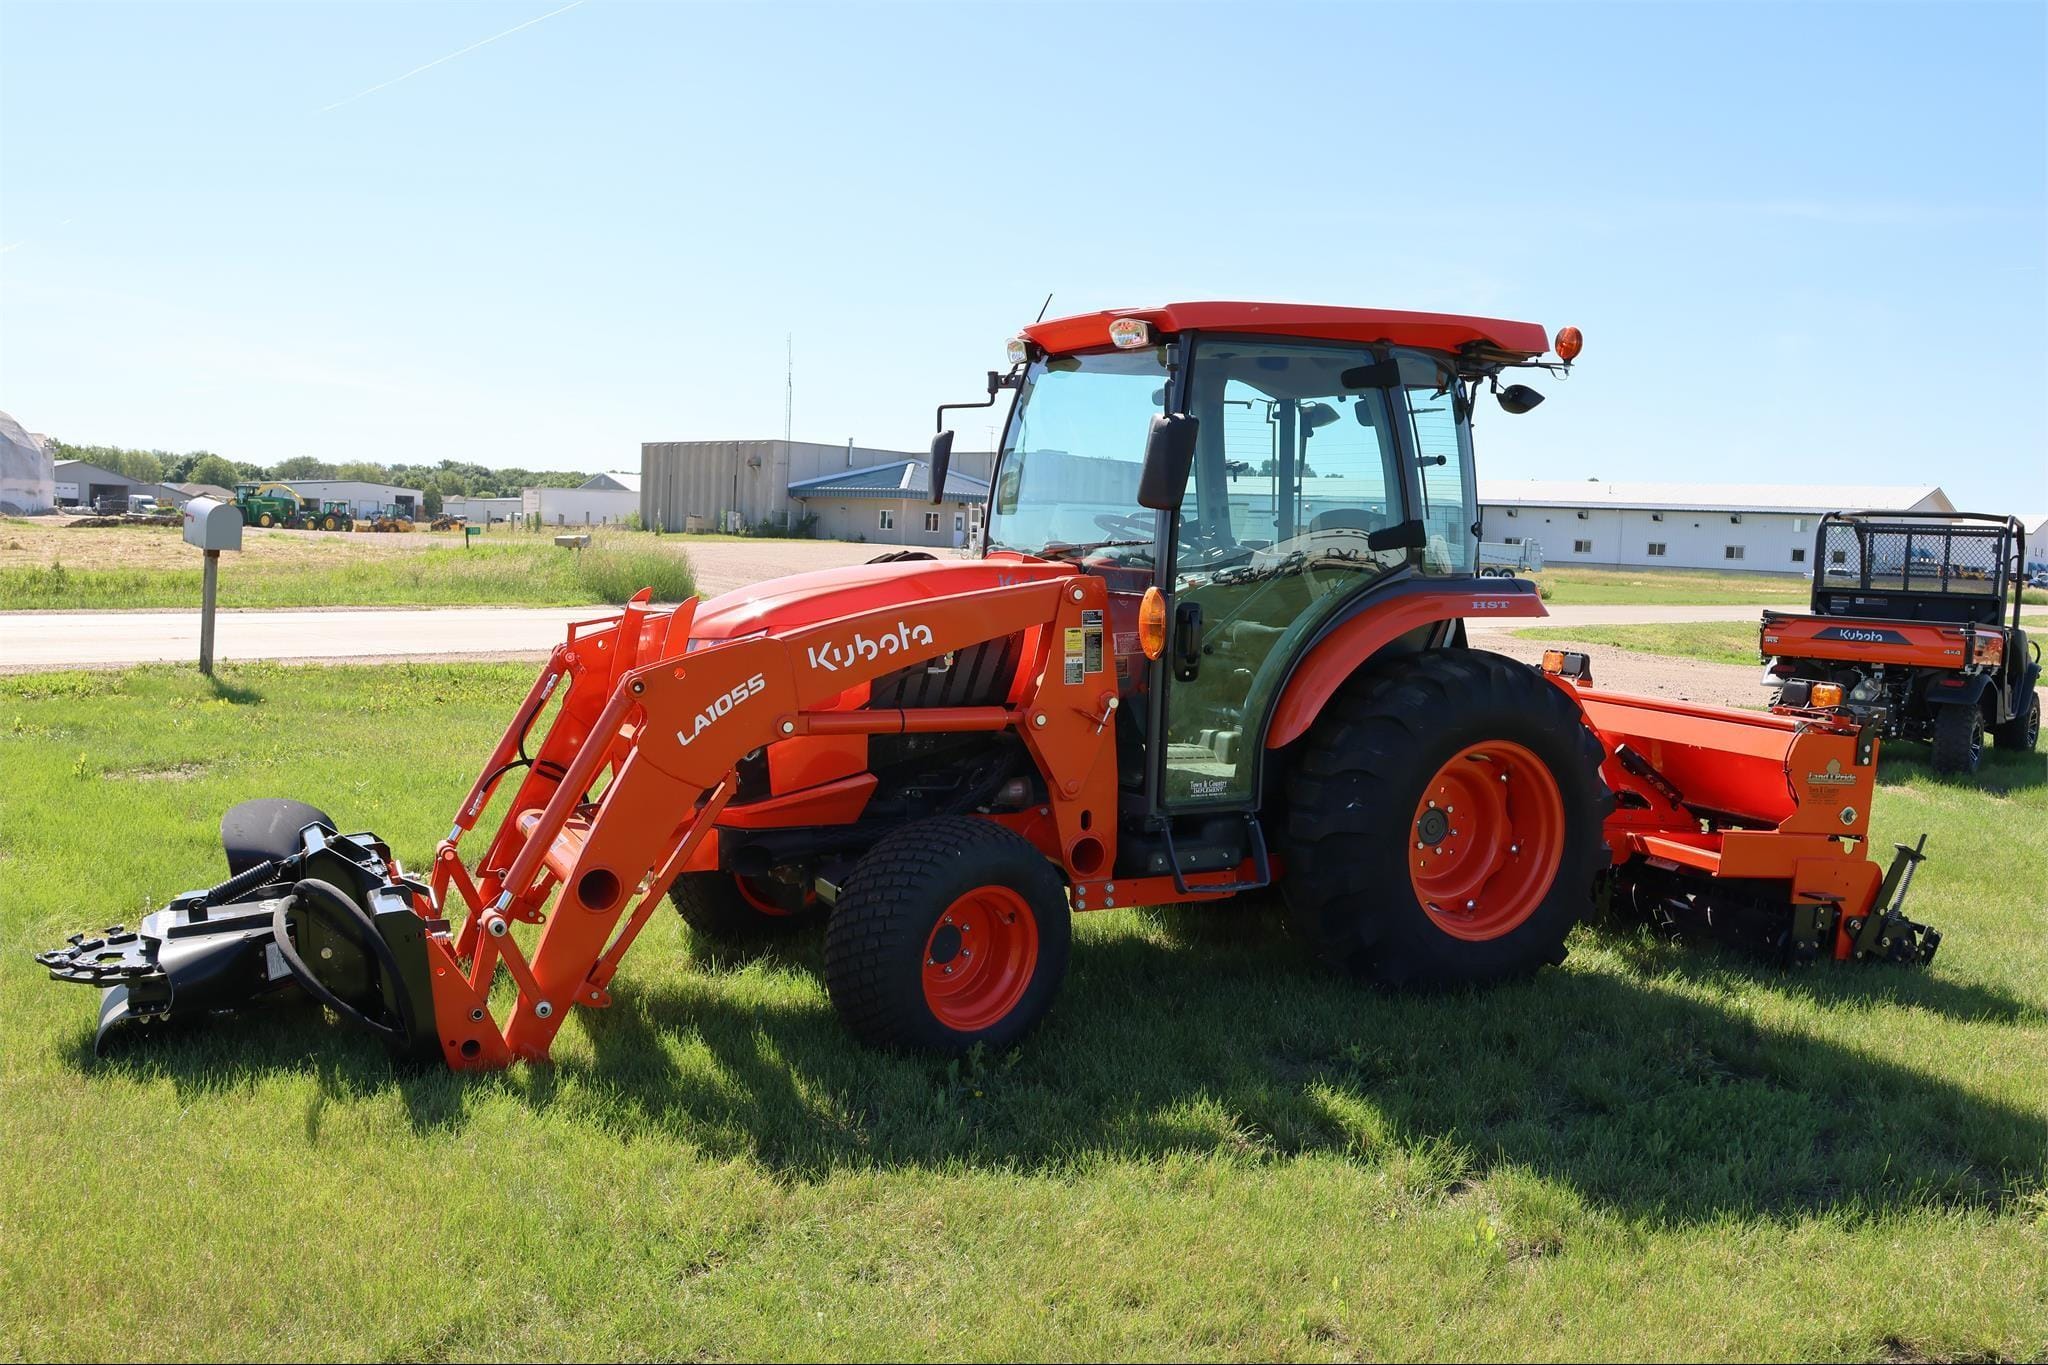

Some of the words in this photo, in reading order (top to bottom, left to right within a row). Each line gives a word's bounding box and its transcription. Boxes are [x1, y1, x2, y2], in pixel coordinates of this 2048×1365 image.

[1472, 601, 1510, 609] HST
[807, 621, 933, 672] Kubota
[1840, 629, 1883, 642] Kubota
[676, 672, 766, 746] LA1055
